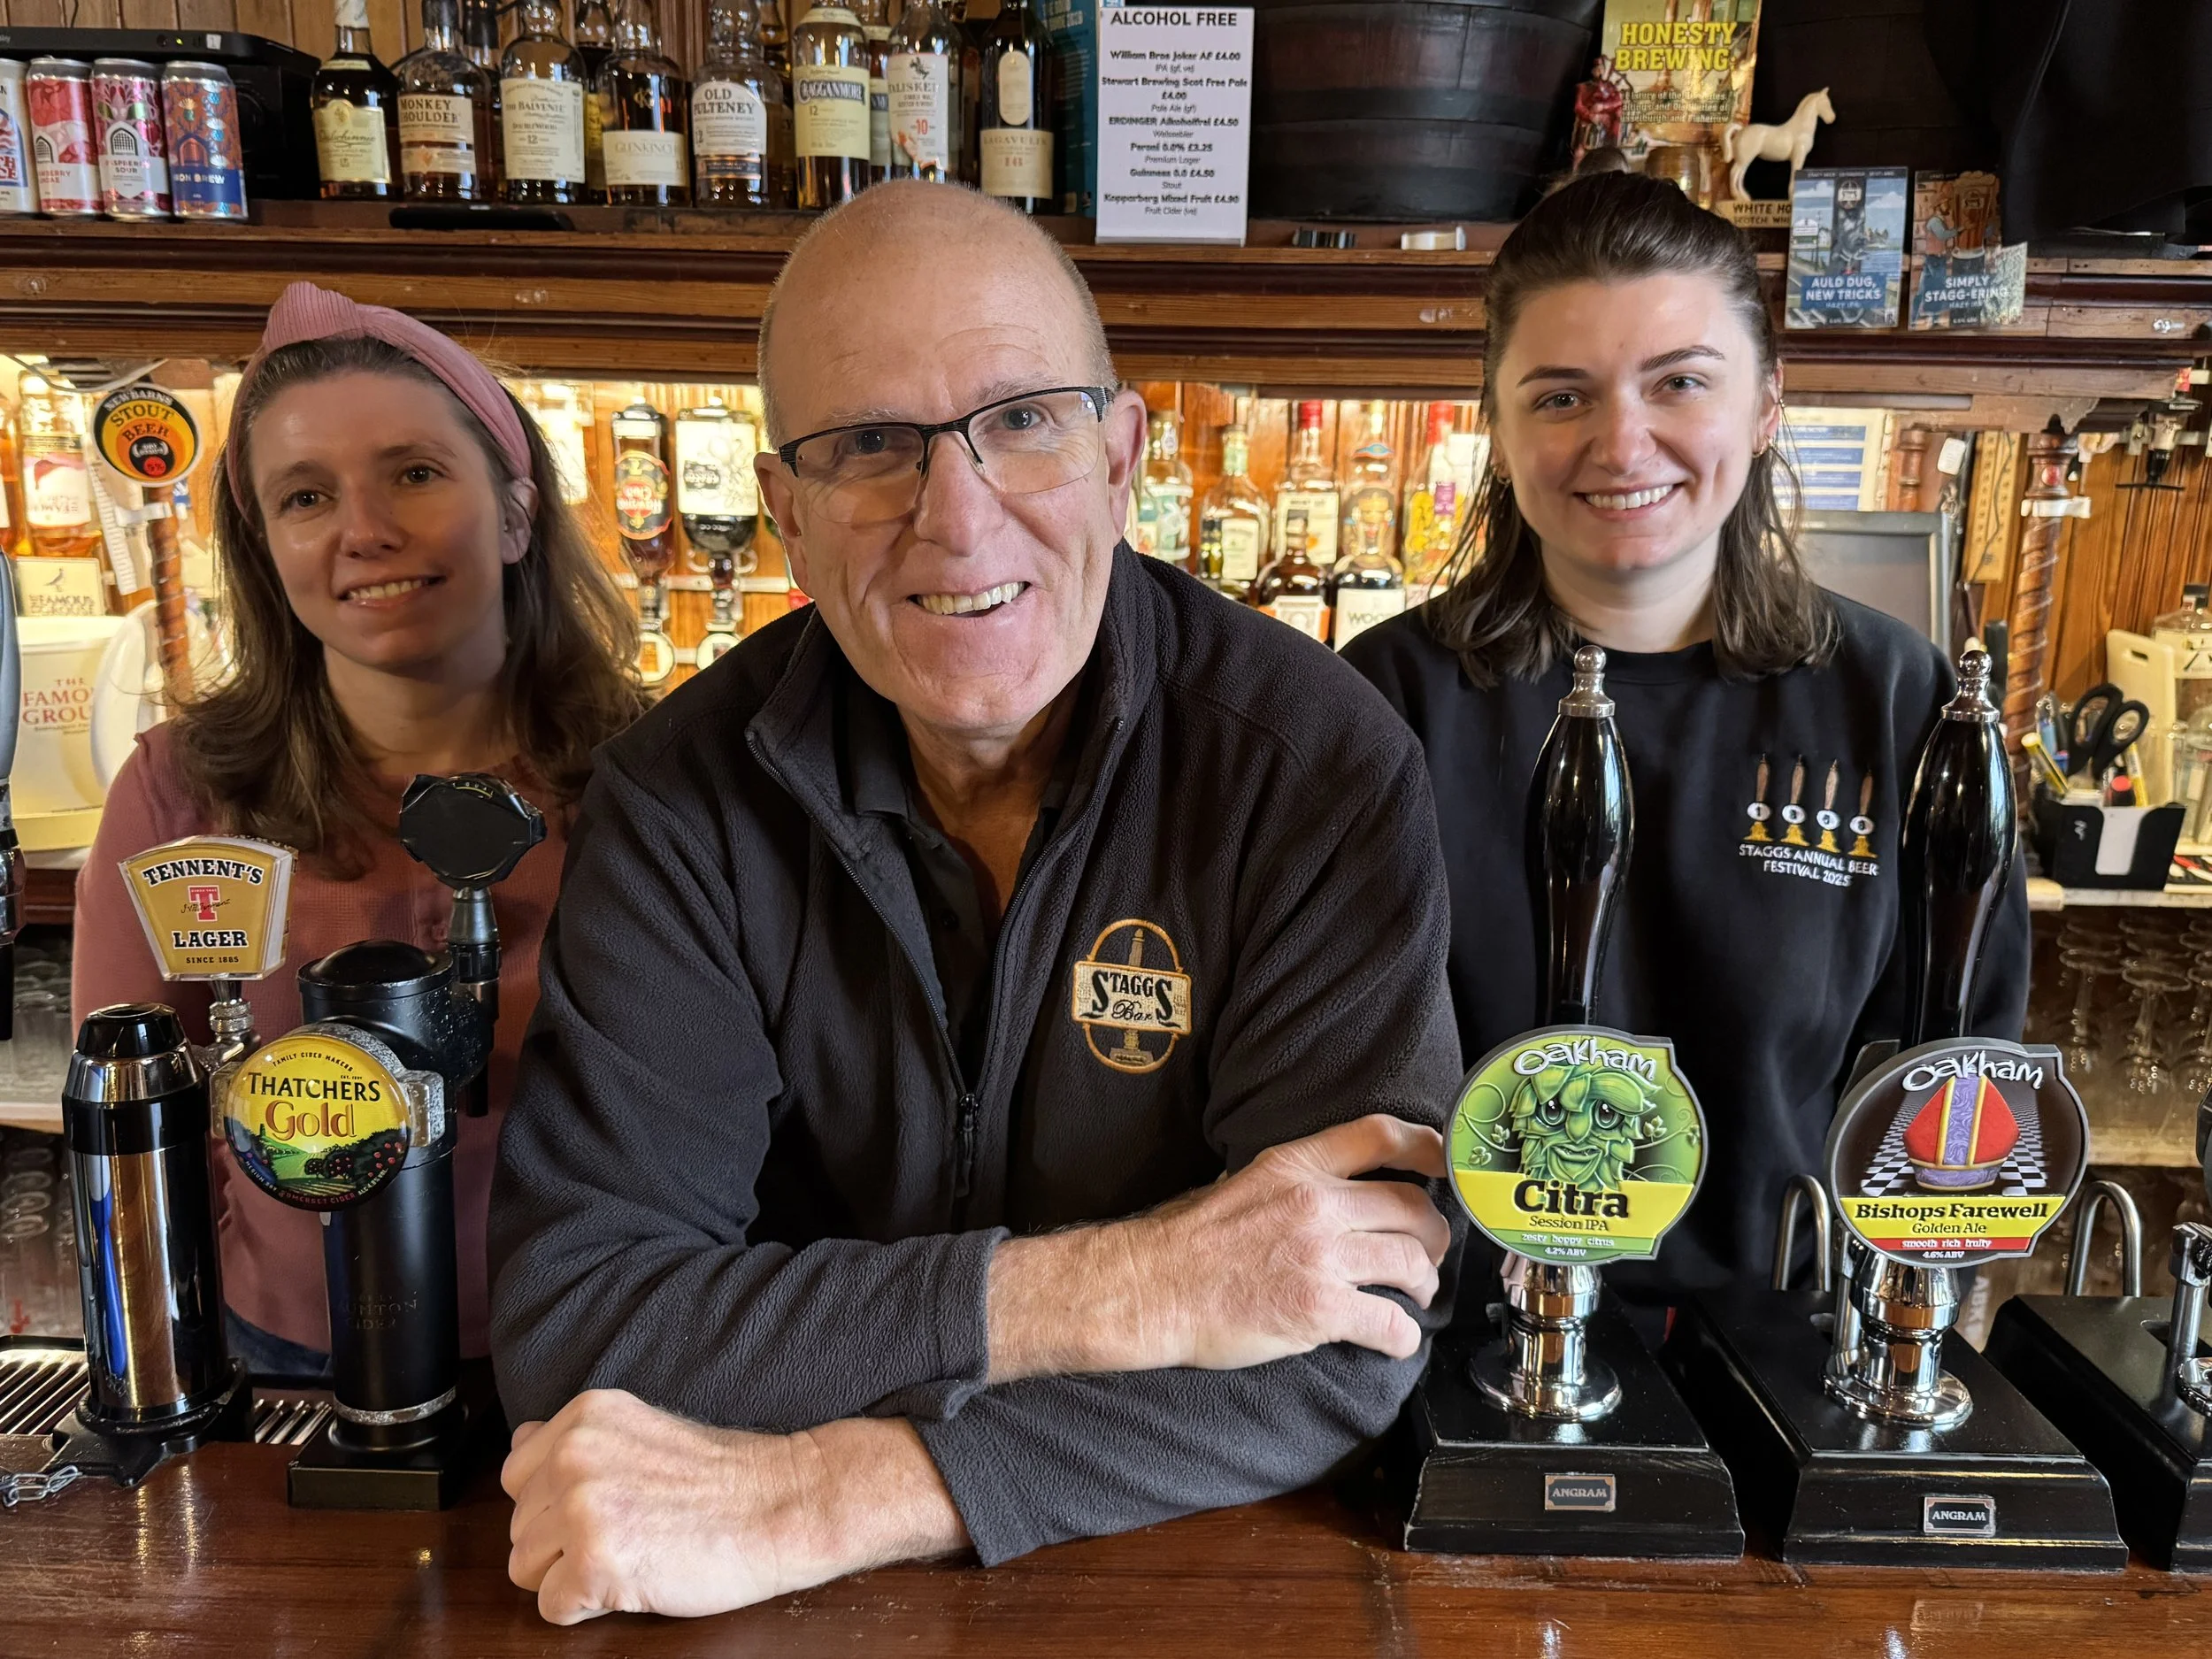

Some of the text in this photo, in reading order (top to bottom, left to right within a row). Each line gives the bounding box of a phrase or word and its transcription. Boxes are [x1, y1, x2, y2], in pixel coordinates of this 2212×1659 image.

[1110, 12, 1237, 27] ALCOHOL FREE
[1621, 22, 1737, 45] HONESTY
[1110, 50, 1146, 60] William
[1149, 51, 1170, 60] Bros
[1102, 77, 1139, 86] Stewart
[1141, 78, 1179, 88] Brewing
[704, 89, 733, 100] OLD
[401, 99, 451, 110] MONKEY
[694, 102, 756, 115] PULTENEY
[810, 105, 818, 116] 12
[916, 119, 927, 135] 10
[1109, 117, 1157, 126] ERDINGER
[527, 134, 538, 145] 12
[1733, 204, 1772, 215] WHITE
[1810, 276, 1877, 289] AULD DUG,
[1946, 276, 1990, 288] SIMPLY
[1806, 288, 1883, 301] NEW TRICKS
[111, 403, 174, 427] STOUT
[122, 424, 169, 442] BEER
[23, 688, 90, 707] FAMO
[22, 706, 91, 725] GROU
[1739, 843, 1880, 877] STAGGS ANNUAL BEER
[142, 858, 265, 887] TENNENT'S
[1763, 860, 1853, 887] FESTIVAL 2025
[173, 931, 248, 948] LAGER
[1091, 970, 1172, 1021] STAGGS
[1111, 999, 1153, 1021] Bar
[273, 1053, 297, 1067] FAMILY
[326, 1056, 354, 1071] MAKERS
[1513, 1039, 1657, 1080] Oakham
[1901, 1050, 2044, 1091] Oakham
[248, 1071, 380, 1102] THATCHERS
[265, 1100, 357, 1141] Gold
[1514, 1179, 1629, 1218] Citra
[1855, 1202, 2048, 1221] Bishops Farewell
[1529, 1216, 1609, 1231] Session IPA
[1912, 1223, 1987, 1233] Golden Ale
[1551, 1234, 1582, 1245] hoppy
[1901, 1239, 1993, 1248] smooth rich fruity
[1566, 1247, 1586, 1256] ABV
[1552, 1487, 1608, 1499] ANGRAM
[1932, 1511, 1987, 1523] ANGRAM
